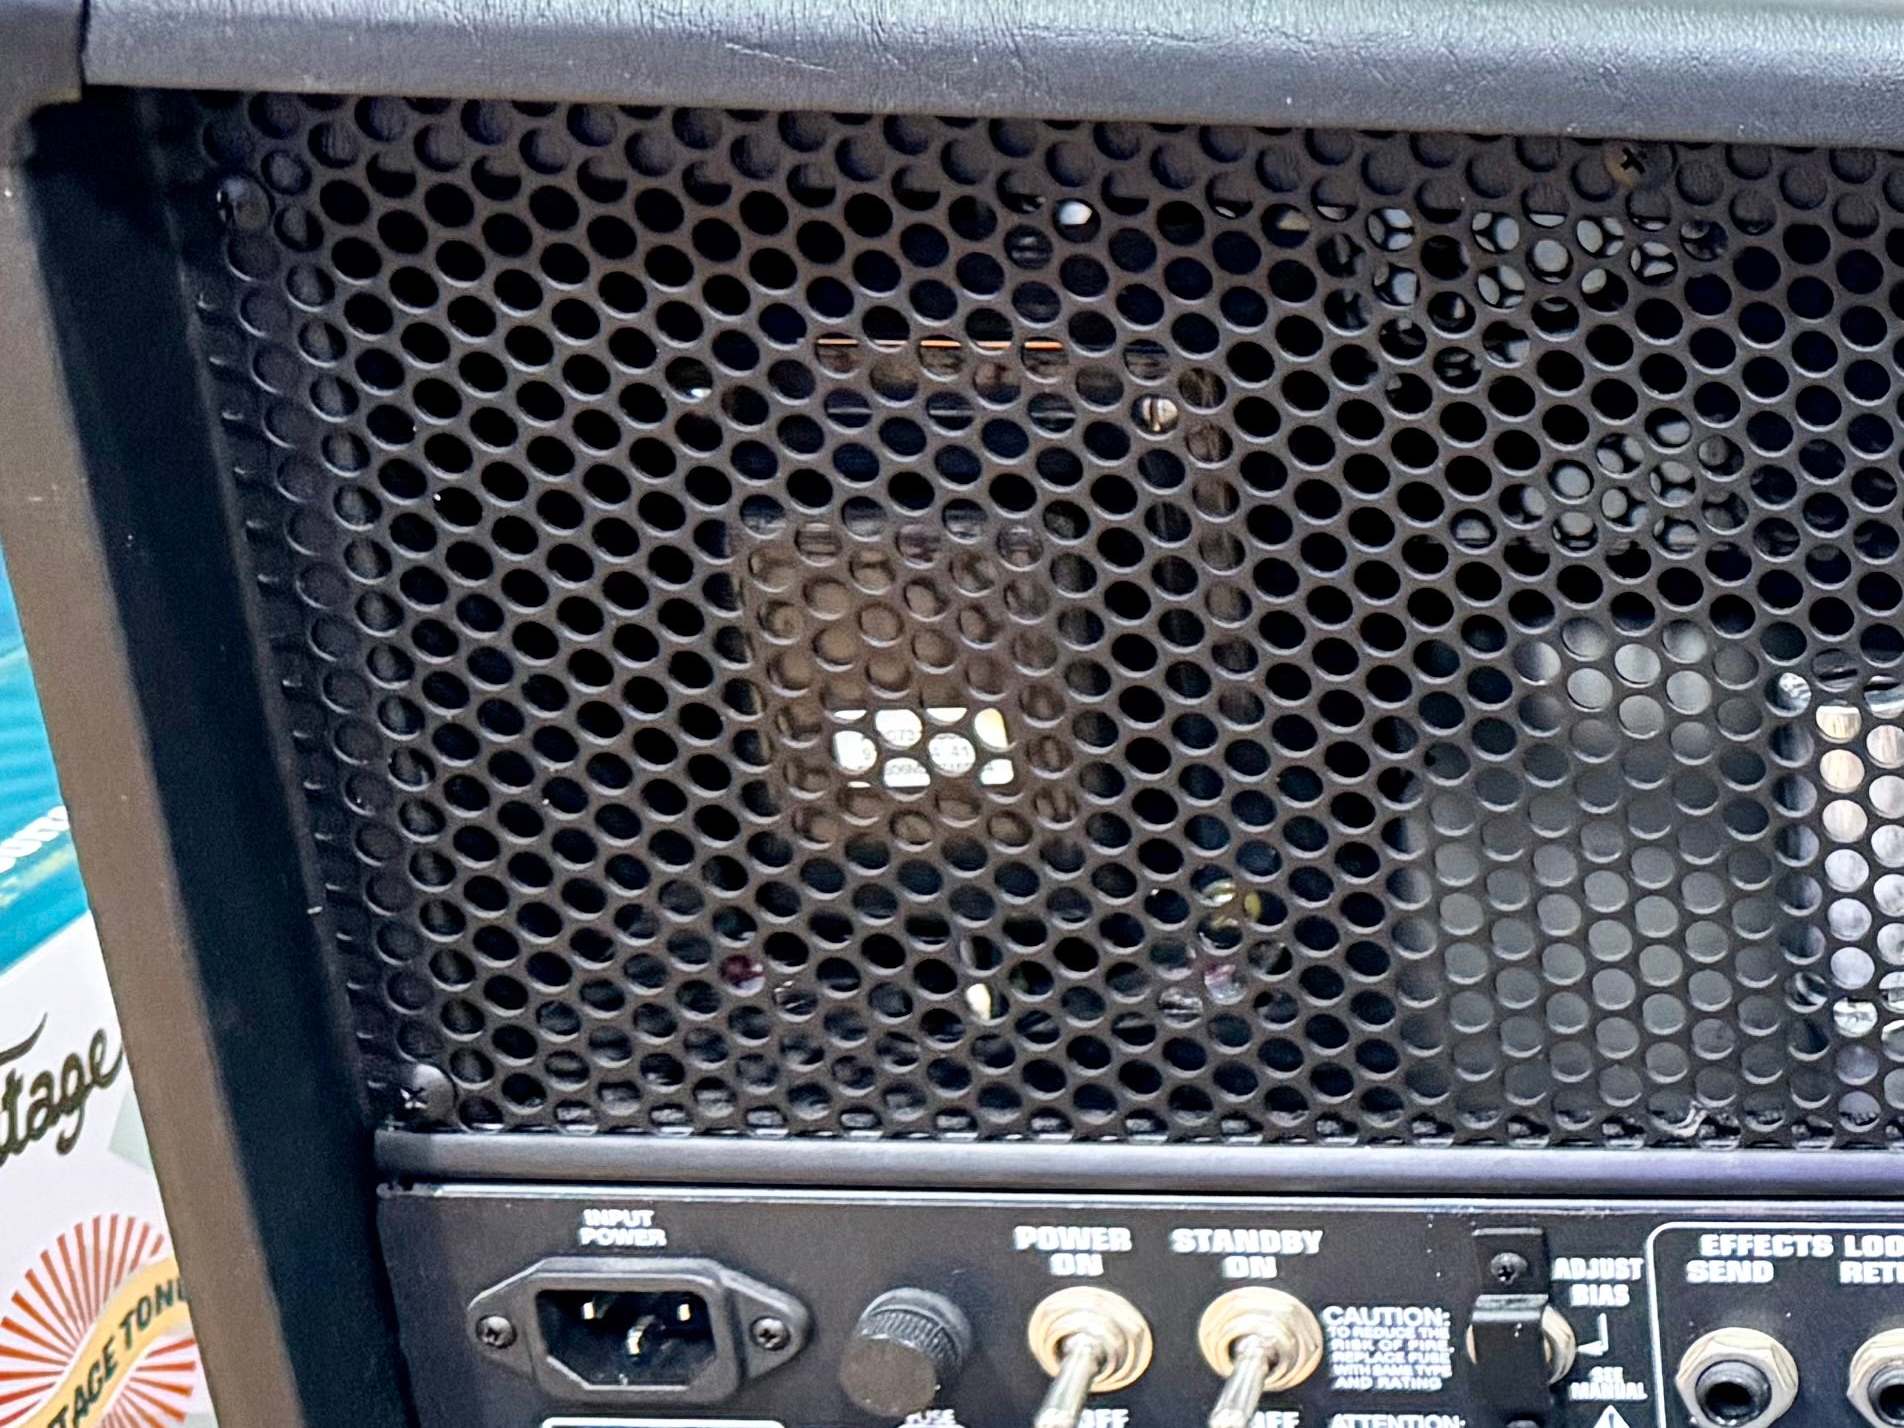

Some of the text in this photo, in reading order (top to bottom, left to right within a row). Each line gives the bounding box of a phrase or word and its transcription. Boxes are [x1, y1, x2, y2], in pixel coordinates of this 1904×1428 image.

[582, 1209, 654, 1227] INPUT
[578, 1228, 667, 1247] POWER
[1014, 1225, 1132, 1252] POWER
[1171, 1228, 1324, 1254] STANDBY
[1701, 1234, 1834, 1258] EFFECTS
[1049, 1253, 1104, 1277] ON
[1224, 1255, 1277, 1278] ON
[1552, 1257, 1645, 1281] ADJUST
[1686, 1260, 1775, 1284] SEND
[1569, 1284, 1630, 1307] BIAS
[1322, 1306, 1451, 1326] CAUTION:
[1328, 1327, 1450, 1339] TO REDUCE THE
[1331, 1339, 1375, 1351] RISK
[1378, 1339, 1404, 1351] OF
[1331, 1352, 1451, 1364] REPLACE FUSE
[1332, 1364, 1371, 1376] WITH
[1417, 1365, 1452, 1378] TYPE
[1333, 1377, 1442, 1390] AND RATING
[1569, 1382, 1648, 1400] MANUAL
